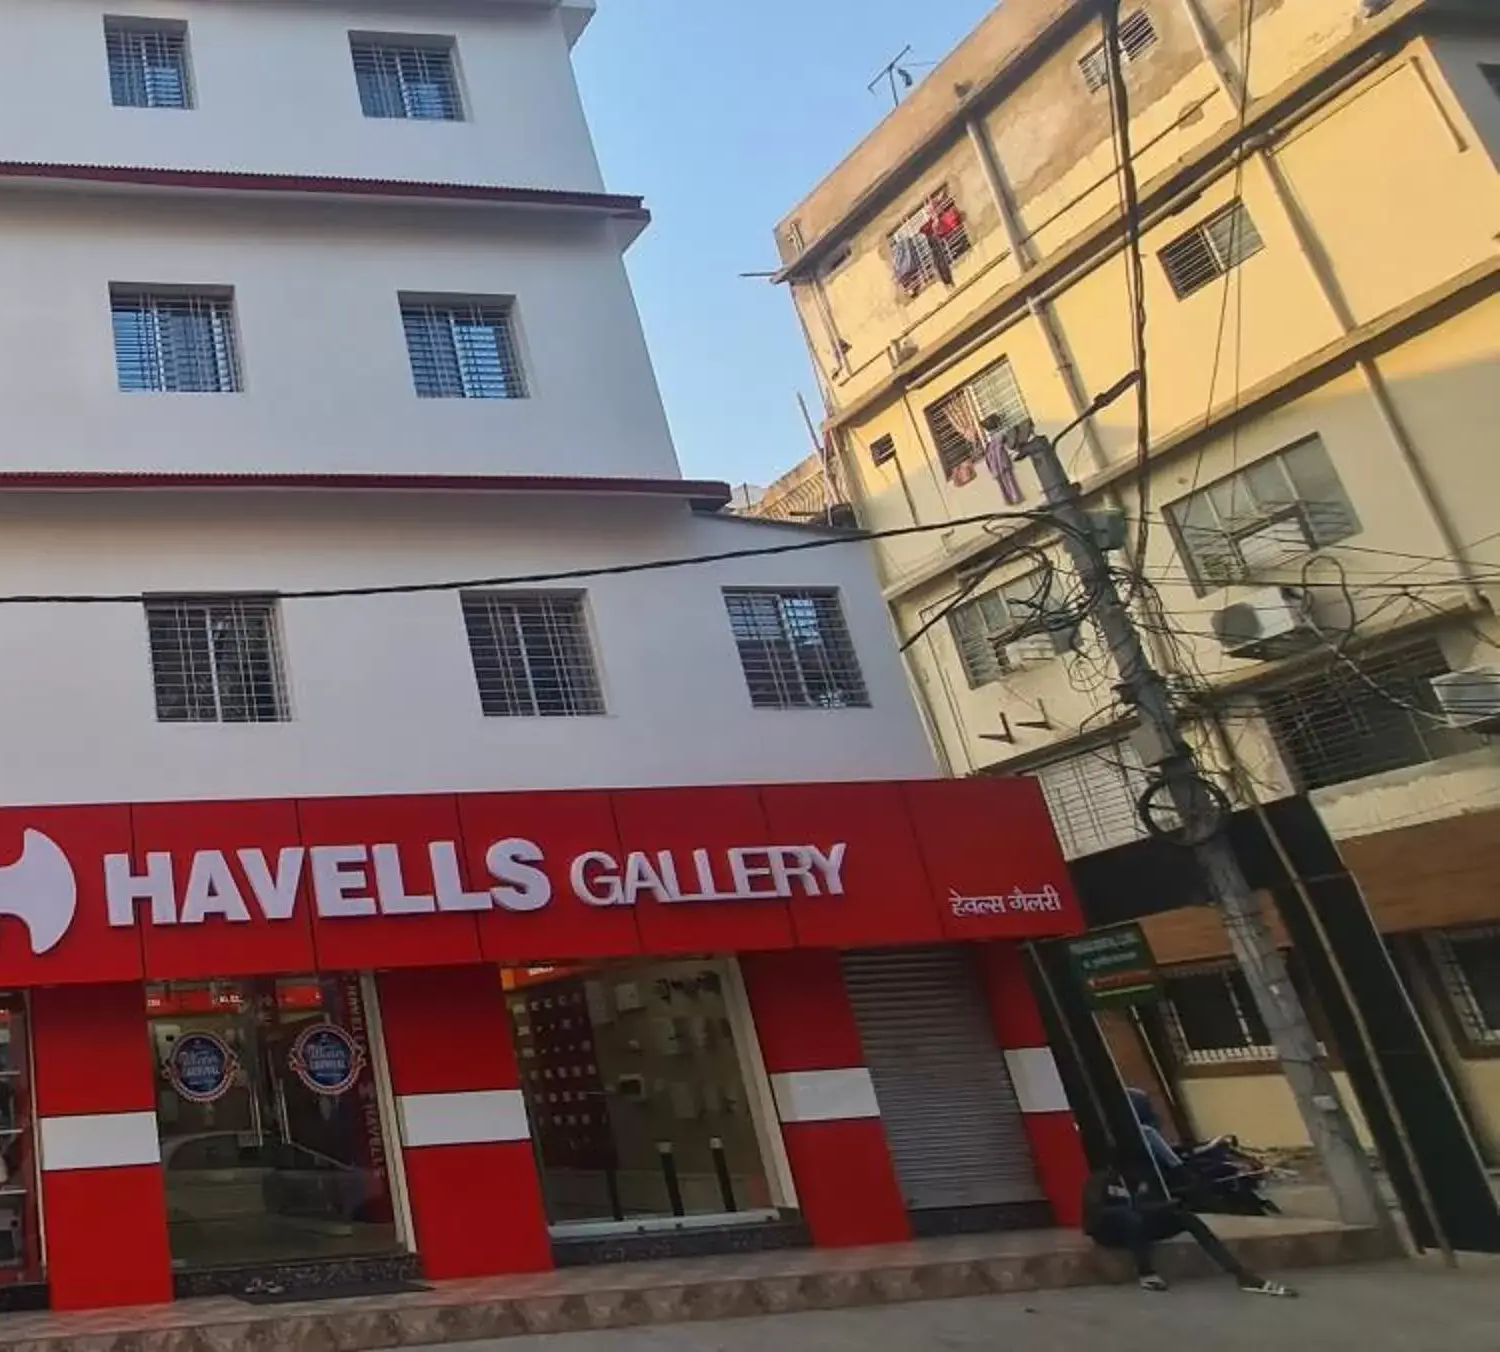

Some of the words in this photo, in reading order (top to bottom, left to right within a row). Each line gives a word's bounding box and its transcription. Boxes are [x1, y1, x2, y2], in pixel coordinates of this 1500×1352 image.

[103, 838, 553, 927] HAVELLS
[569, 842, 848, 906] GALLERY
[948, 887, 1006, 917] हेवल्स
[1007, 884, 1062, 912] गैलरी
